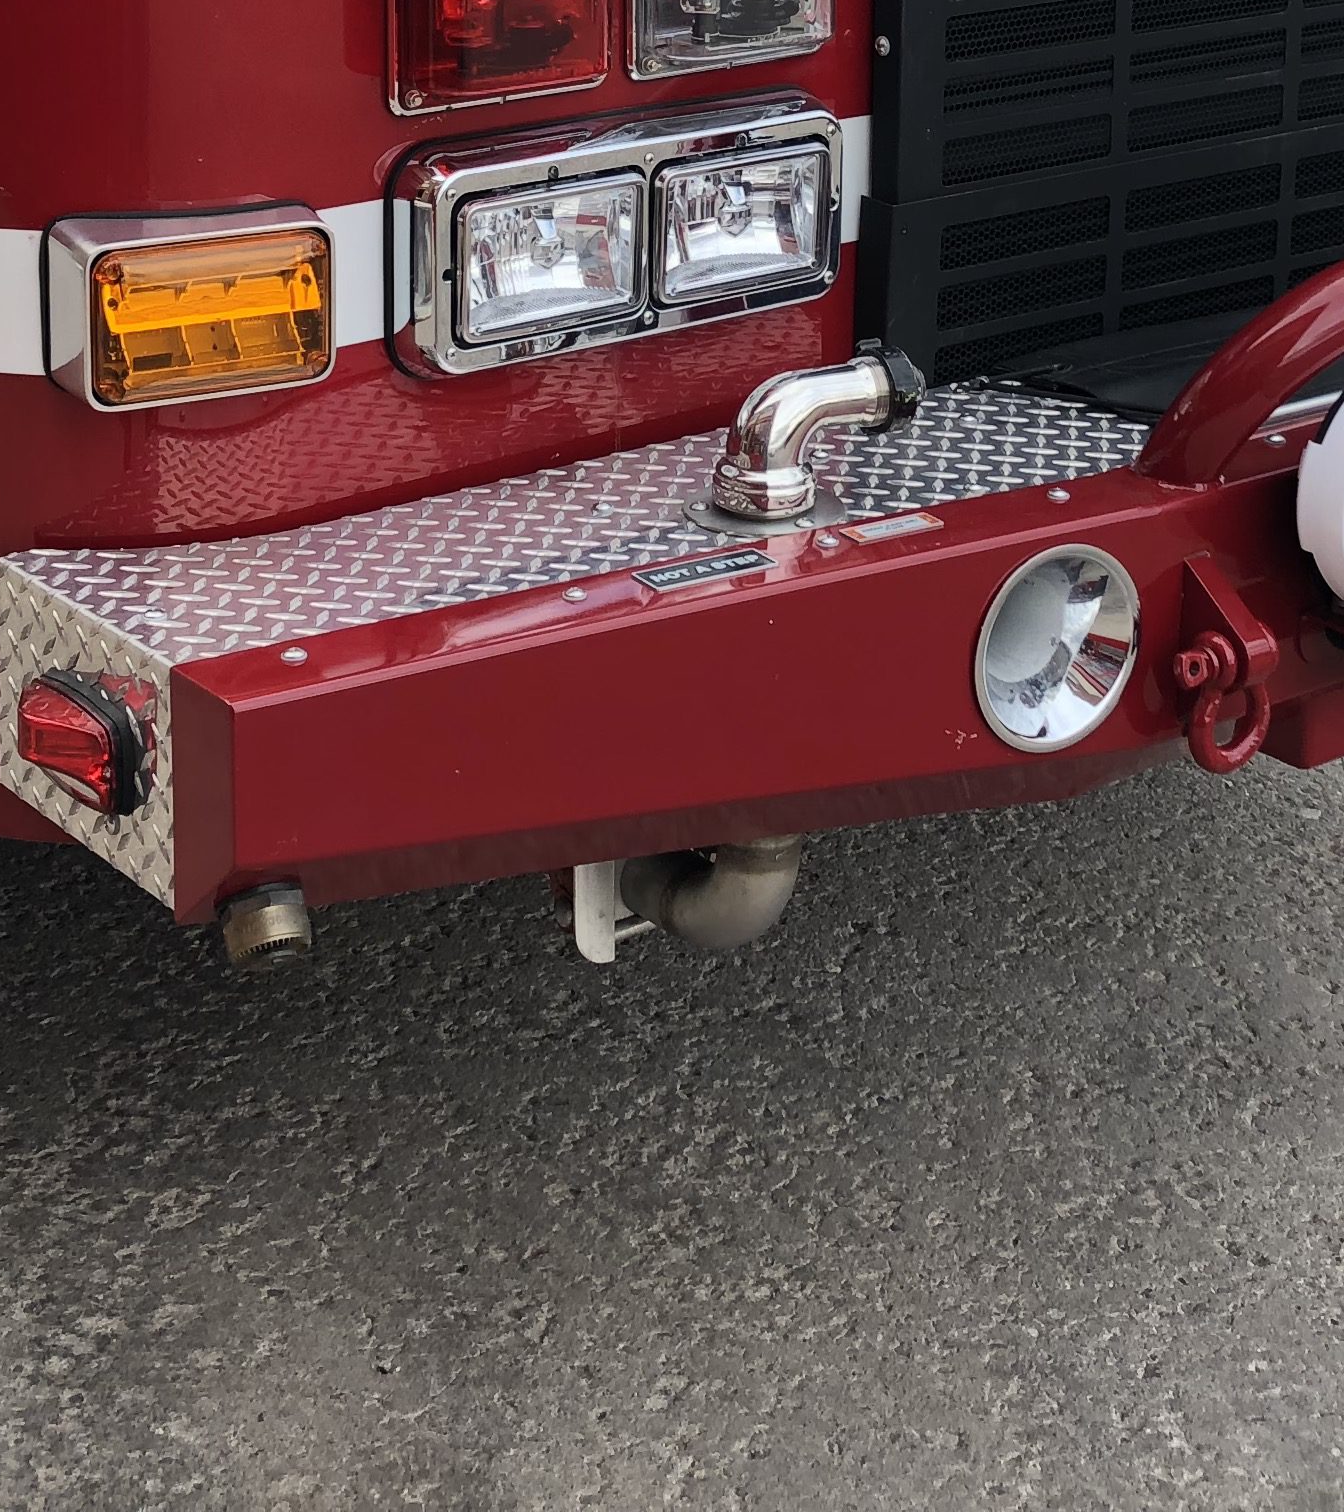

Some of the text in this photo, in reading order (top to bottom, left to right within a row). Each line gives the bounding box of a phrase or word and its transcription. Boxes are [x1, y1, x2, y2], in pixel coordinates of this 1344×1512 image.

[648, 554, 759, 583] NOT A STEP
